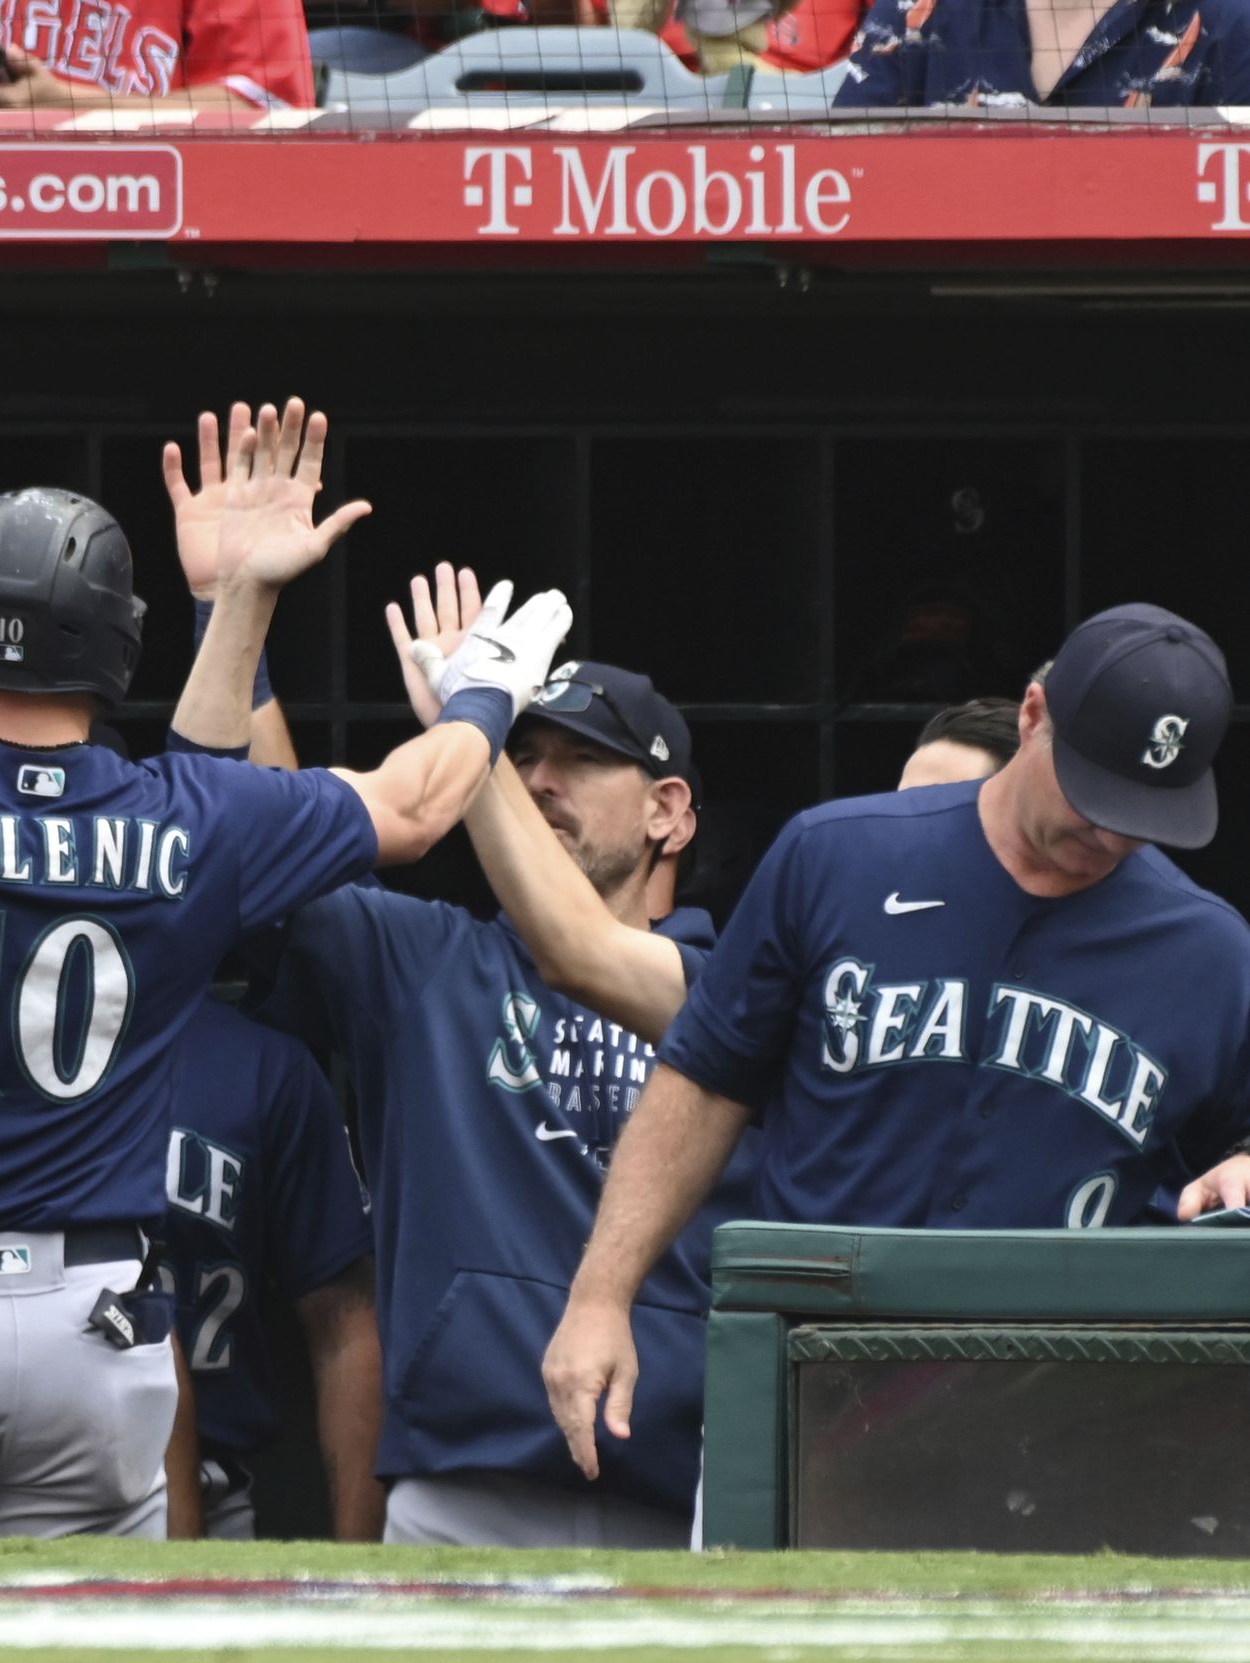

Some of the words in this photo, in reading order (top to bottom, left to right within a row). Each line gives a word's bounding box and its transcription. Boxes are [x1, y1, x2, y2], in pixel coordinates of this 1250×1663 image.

[553, 144, 852, 236] Mobile
[0, 617, 24, 644] 10
[822, 957, 1169, 1152] SEATTLE
